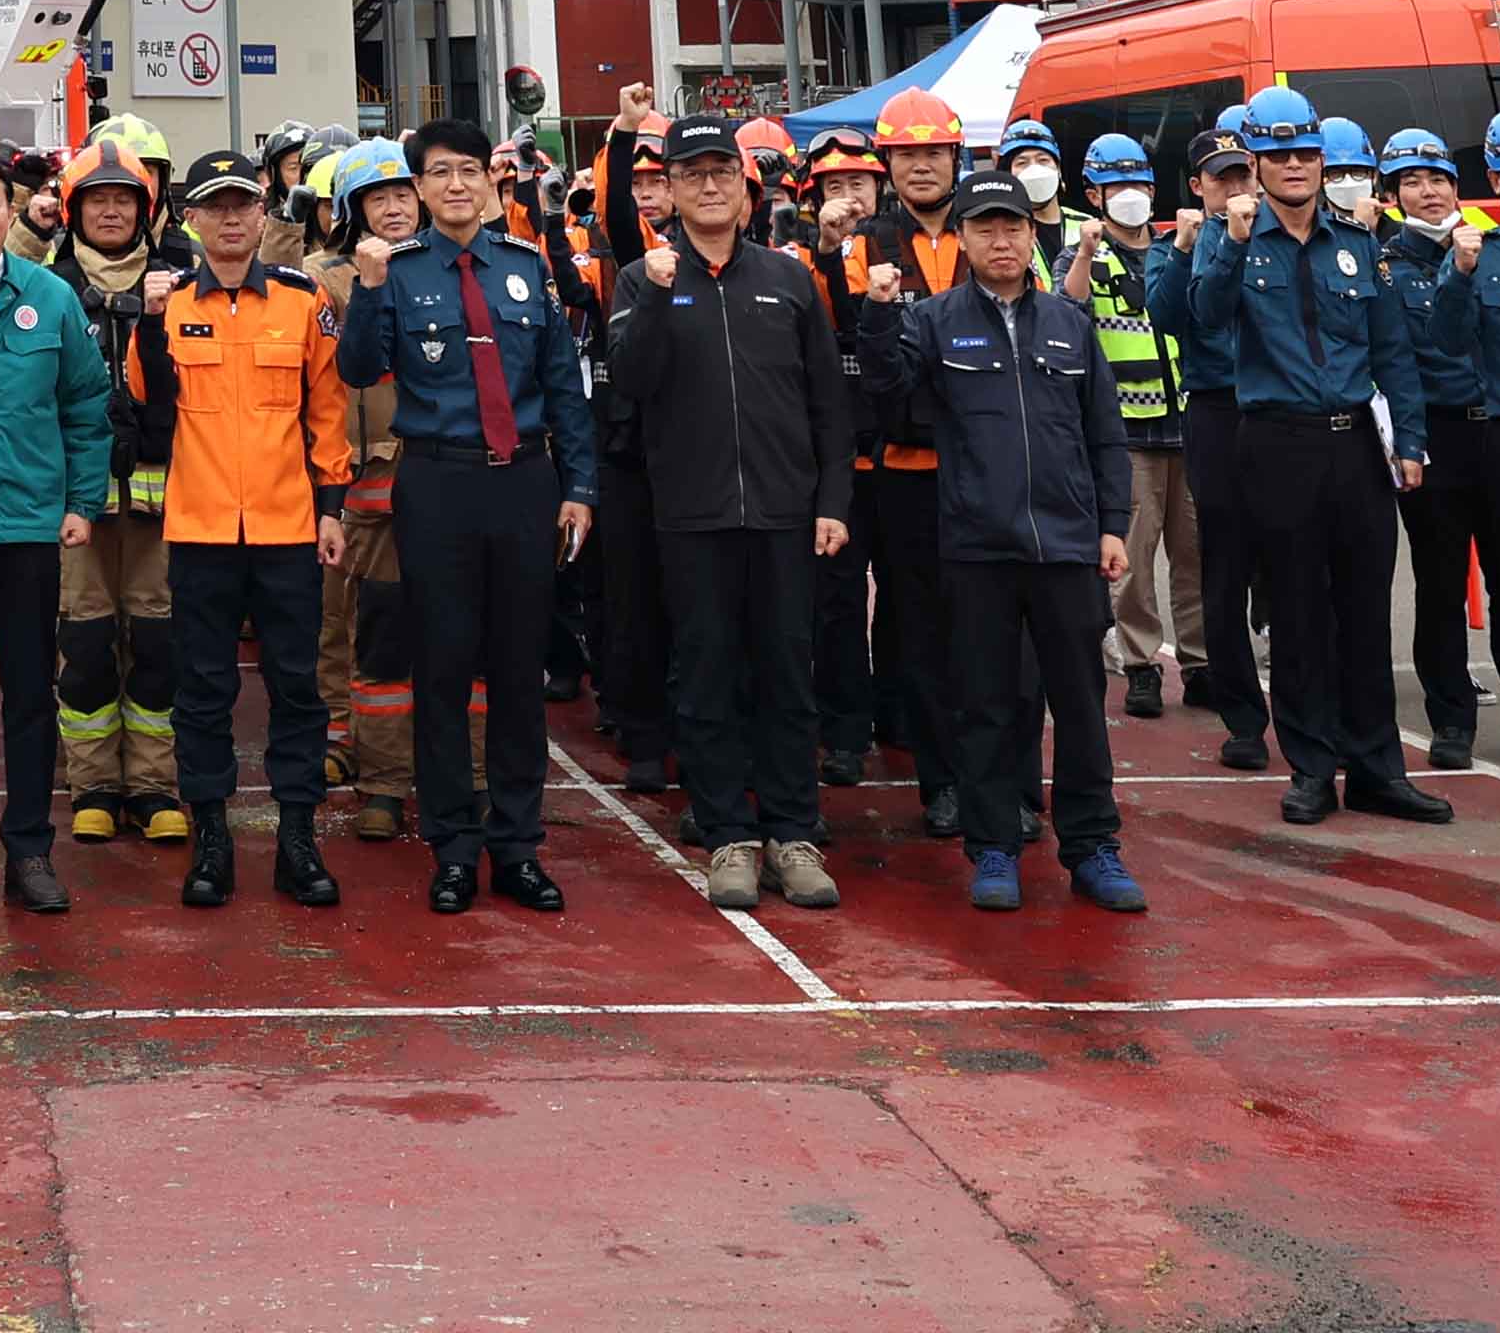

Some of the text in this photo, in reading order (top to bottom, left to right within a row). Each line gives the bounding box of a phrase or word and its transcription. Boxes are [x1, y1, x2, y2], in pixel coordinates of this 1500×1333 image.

[137, 40, 176, 59] 휴대폰
[147, 63, 168, 77] NO
[682, 127, 721, 139] DOOSAN
[972, 182, 1012, 194] DOOSAN
